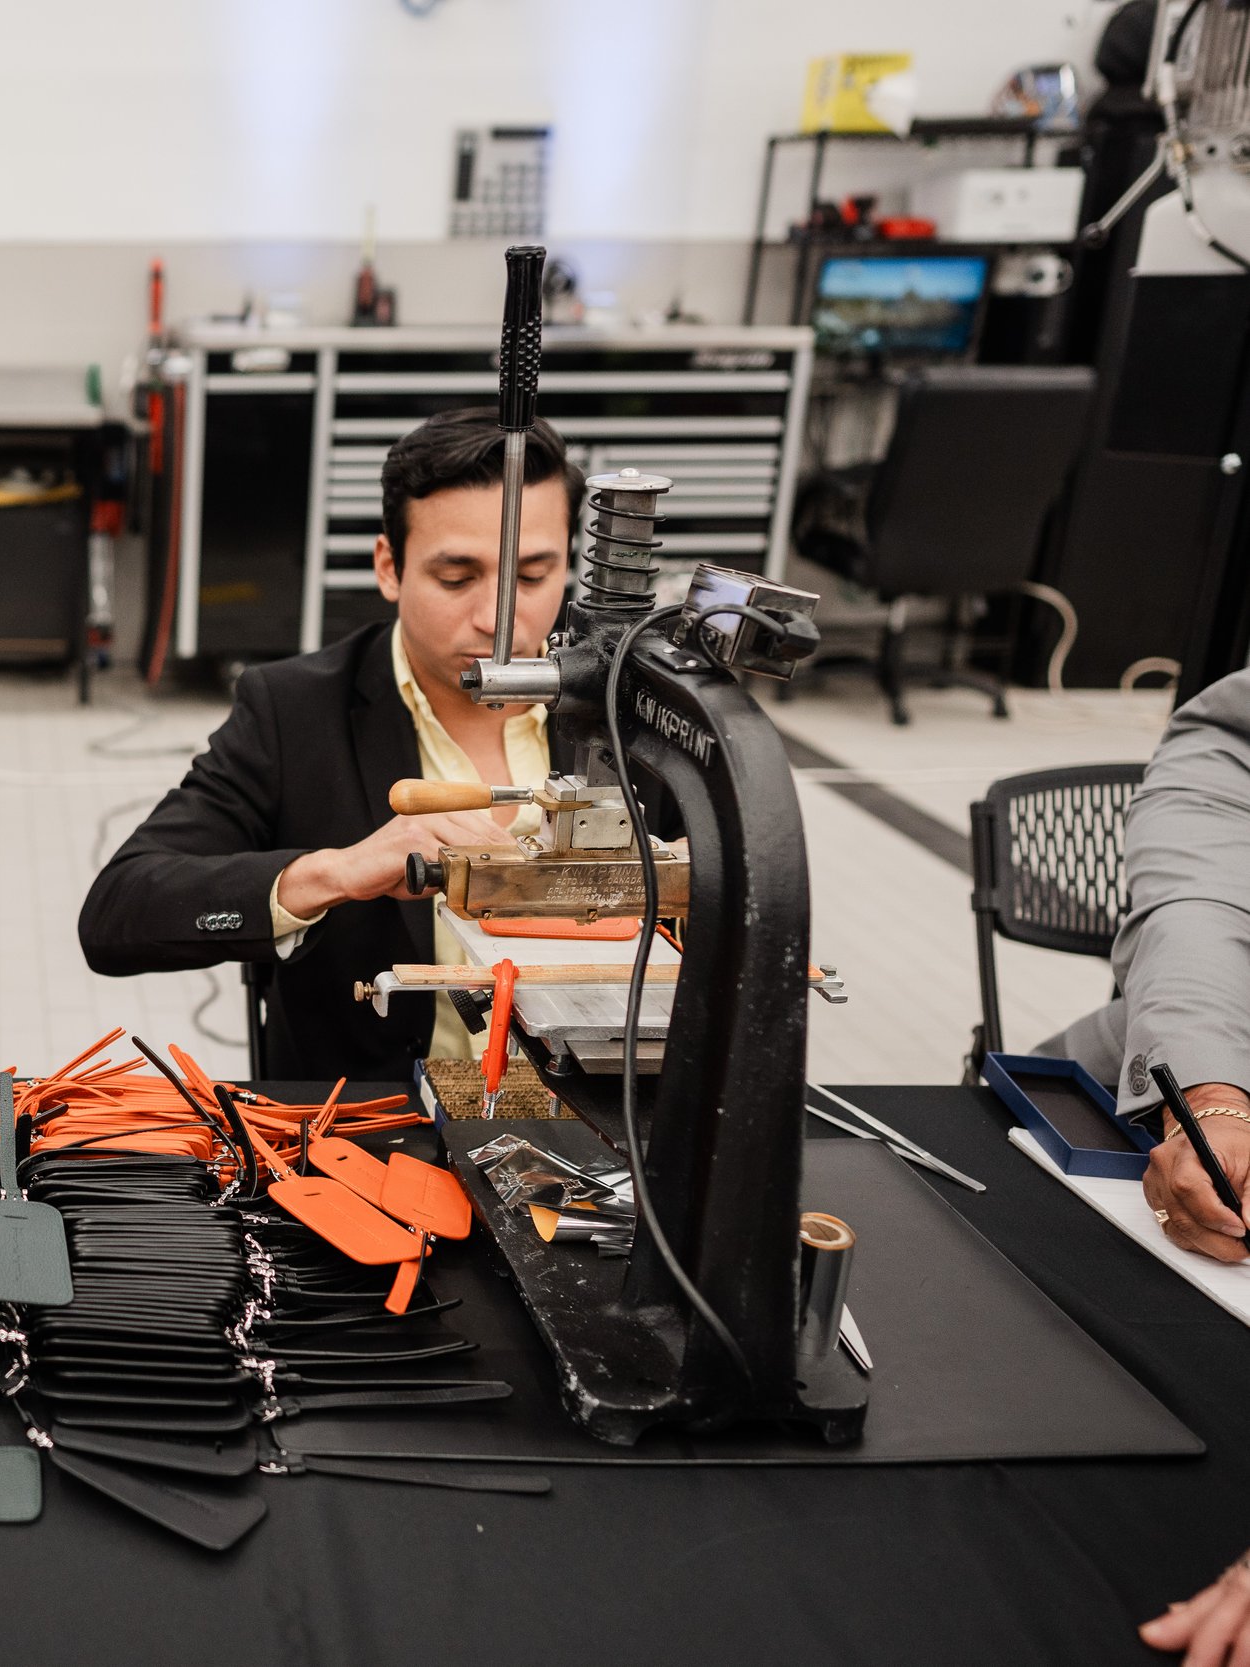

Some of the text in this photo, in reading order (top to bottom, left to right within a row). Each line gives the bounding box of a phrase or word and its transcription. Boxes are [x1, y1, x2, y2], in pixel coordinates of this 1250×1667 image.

[636, 690, 715, 767] KWIKPRINT
[561, 865, 642, 876] KWIKPRINT
[607, 877, 642, 885] CANADA
